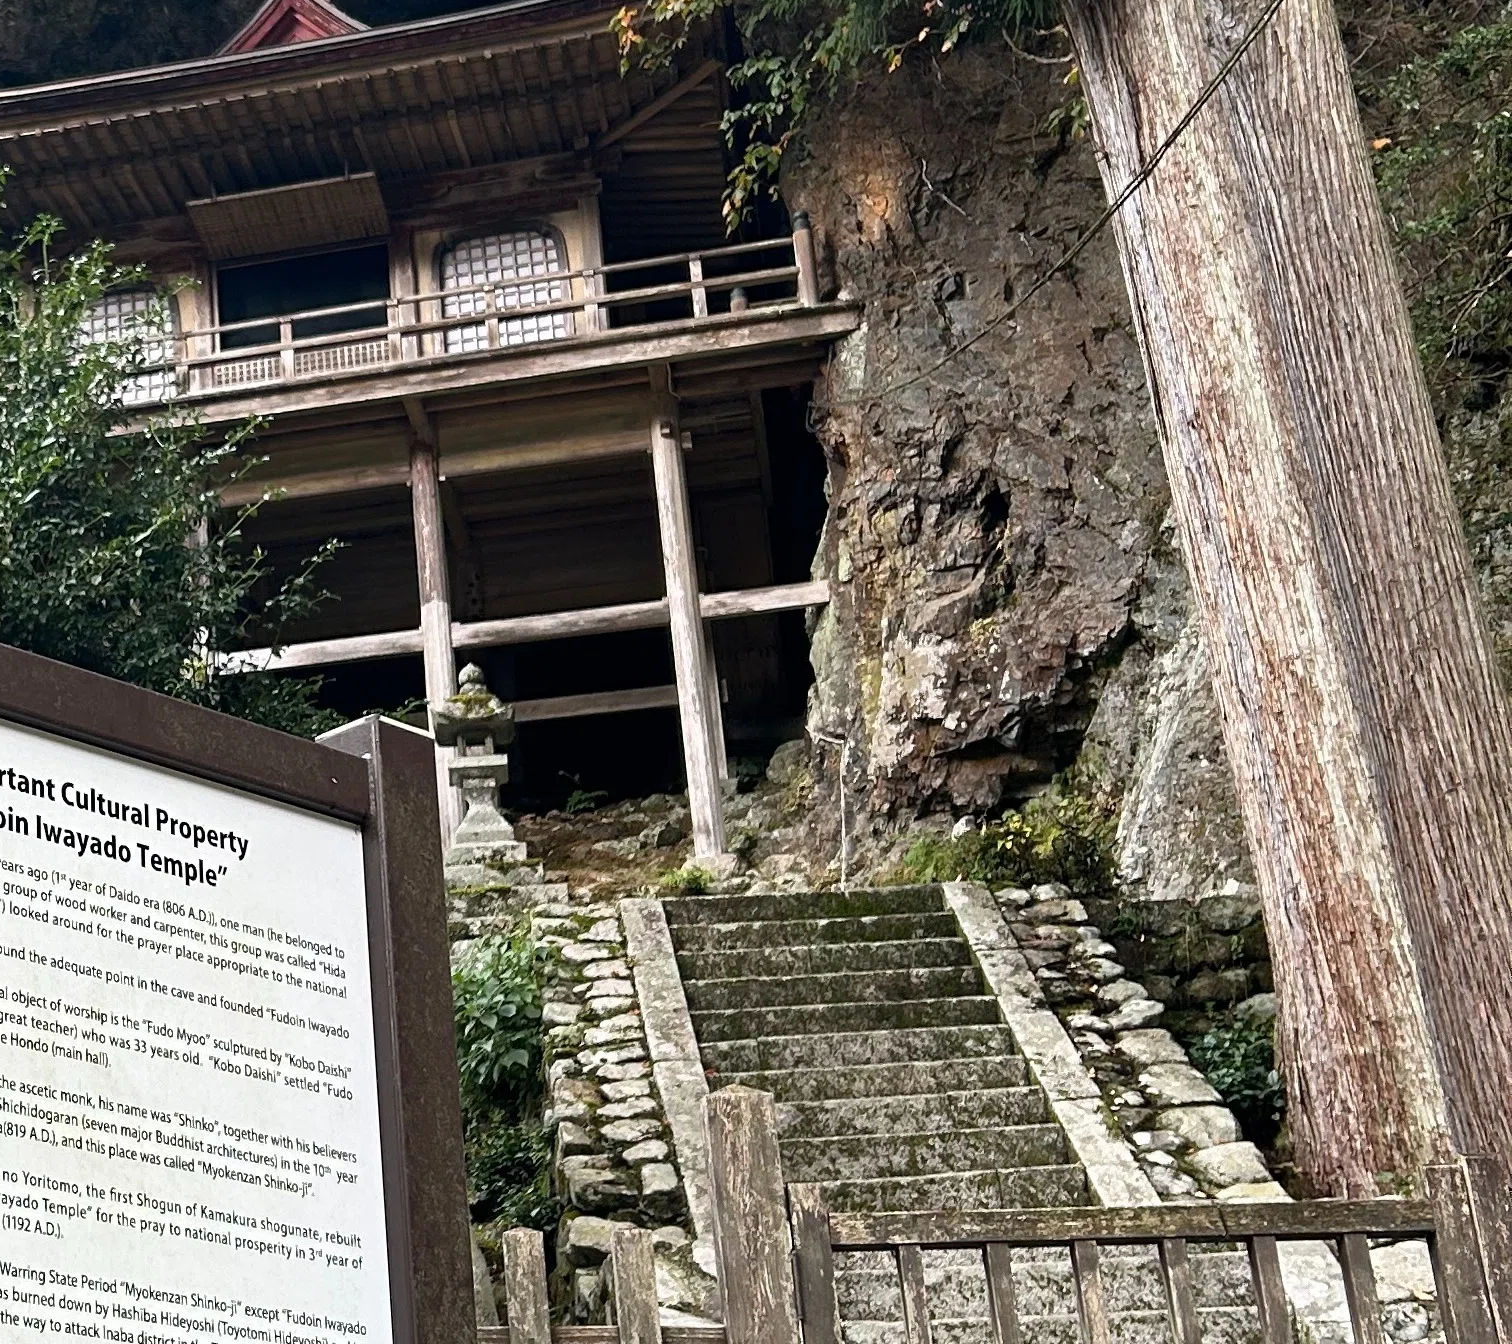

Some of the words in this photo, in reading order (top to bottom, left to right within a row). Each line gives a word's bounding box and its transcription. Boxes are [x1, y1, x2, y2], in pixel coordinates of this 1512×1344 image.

[35, 814, 132, 864] Iwayado
[60, 781, 150, 829] Cultural
[155, 807, 249, 862] Property
[8, 899, 50, 925] looked
[50, 914, 95, 936] around
[95, 921, 114, 941] for
[114, 927, 136, 947] the
[136, 935, 174, 956] prayer
[174, 943, 206, 964] place
[205, 953, 271, 981] appropriate
[270, 968, 284, 984] to
[284, 971, 304, 990] the
[304, 978, 349, 1001] national
[27, 948, 49, 967] the
[48, 954, 104, 981] adequate
[104, 969, 136, 989] point
[136, 974, 149, 992] in
[149, 977, 170, 997] the
[169, 985, 196, 1003] cave
[195, 992, 219, 1009] and
[218, 994, 265, 1020] founded
[306, 1016, 351, 1041] Iwayado
[0, 1211, 33, 1234] (1192
[1, 1169, 20, 1185] no
[20, 1169, 83, 1199] Yoritomo,
[84, 1181, 107, 1201] the
[108, 1185, 135, 1207] first
[135, 1191, 183, 1216] Shogun
[184, 1201, 199, 1219] of
[199, 1203, 259, 1230] Kamakura
[259, 1215, 324, 1245] shogunate,
[324, 1229, 363, 1250] rebuilt
[94, 1205, 115, 1225] for
[115, 1210, 138, 1230] the
[138, 1217, 167, 1238] pray
[168, 1221, 183, 1238] to
[183, 1225, 233, 1247] national
[233, 1235, 294, 1262] prosperity
[294, 1243, 307, 1261] in
[324, 1252, 350, 1269] year
[350, 1254, 365, 1272] of
[11, 1284, 57, 1309] burned
[57, 1292, 93, 1315] down
[93, 1298, 111, 1321] by
[110, 1301, 159, 1325] Hashiba
[159, 1309, 216, 1335] Hideyoshi
[216, 1318, 273, 1344] (Toyotomi
[21, 1314, 48, 1335] way
[48, 1317, 63, 1334] to
[63, 1320, 102, 1340] attack
[101, 1323, 135, 1344] Inaba
[47, 1268, 79, 1289] State
[79, 1273, 119, 1295] Period
[243, 1304, 281, 1325] except
[323, 1314, 368, 1337] Iwayado
